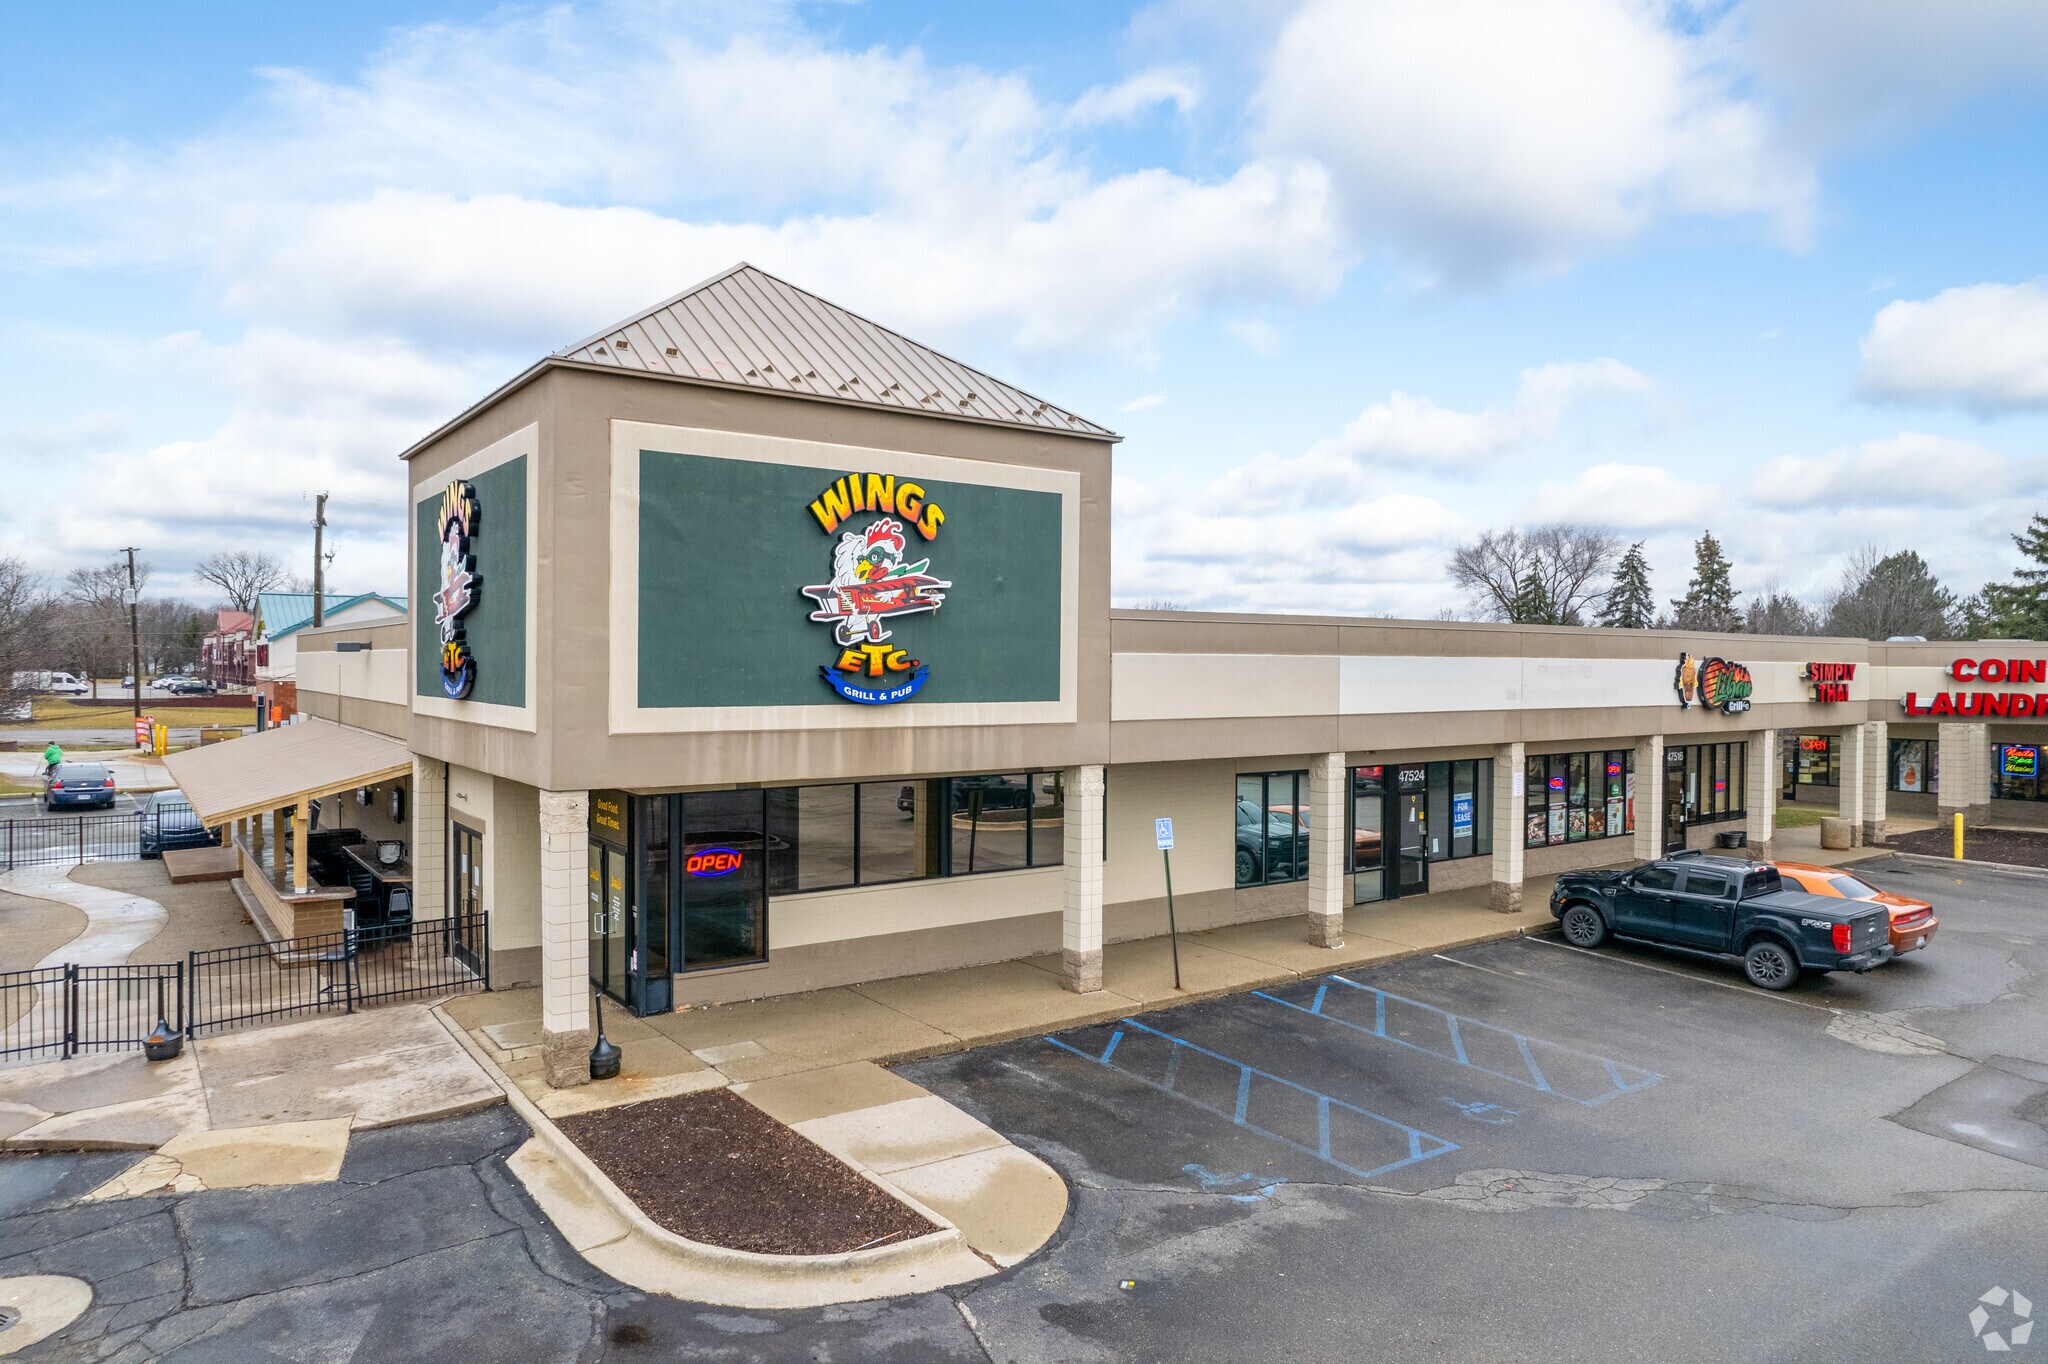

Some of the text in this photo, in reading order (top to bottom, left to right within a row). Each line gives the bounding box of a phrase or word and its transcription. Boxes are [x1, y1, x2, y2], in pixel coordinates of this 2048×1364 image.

[438, 479, 473, 544] WINGS
[808, 472, 946, 541] WINGS
[837, 644, 919, 676] ETC.
[1810, 662, 1856, 681] SIMPLY
[1952, 658, 2047, 683] COIN
[1712, 670, 1752, 702] Liban
[843, 685, 913, 701] GRILL & PUB
[1818, 684, 1849, 702] THAI
[1728, 701, 1743, 711] Grill
[1801, 740, 1826, 751] OPEN
[1667, 752, 1684, 761] 47516
[2008, 756, 2034, 764] Spa
[1608, 765, 1620, 773] OPEN
[2005, 763, 2034, 774] Waxing
[1398, 770, 1425, 782] 47524
[597, 799, 608, 811] Good
[1457, 802, 1469, 811] FOR
[596, 813, 607, 826] Great
[1454, 812, 1471, 823] LEASE
[686, 853, 742, 873] OPEN
